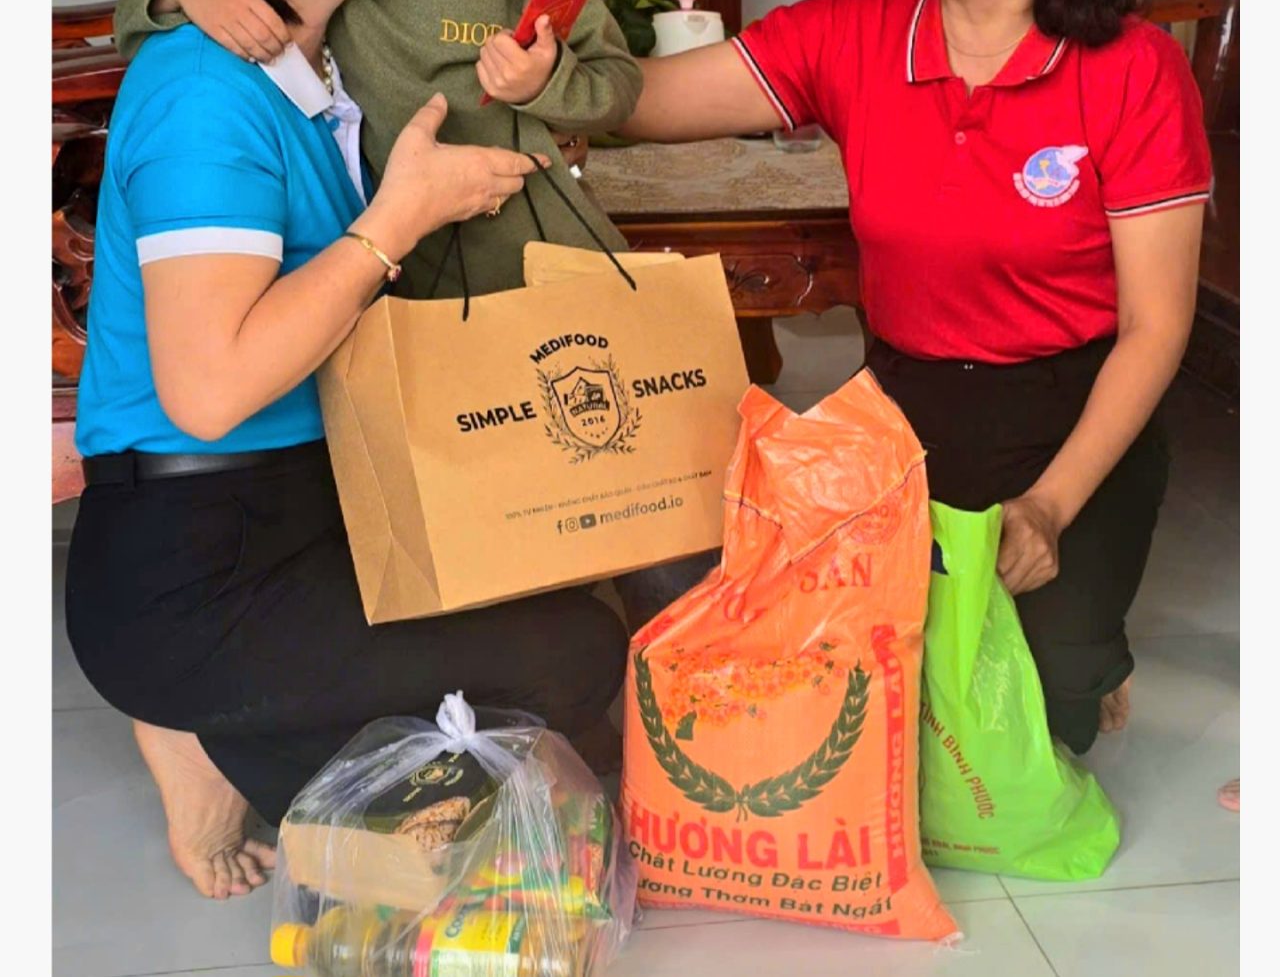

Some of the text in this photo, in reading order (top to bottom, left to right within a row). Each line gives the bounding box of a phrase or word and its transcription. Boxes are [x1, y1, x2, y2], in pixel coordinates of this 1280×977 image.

[529, 333, 609, 364] MEDIFOOD
[632, 368, 707, 399] SNACKS
[456, 401, 537, 433] SIMPLE
[600, 494, 684, 525] medifood.io
[628, 802, 873, 870] HƯƠNG LÀI
[701, 887, 770, 907] Thơm
[831, 870, 882, 896] Biệt
